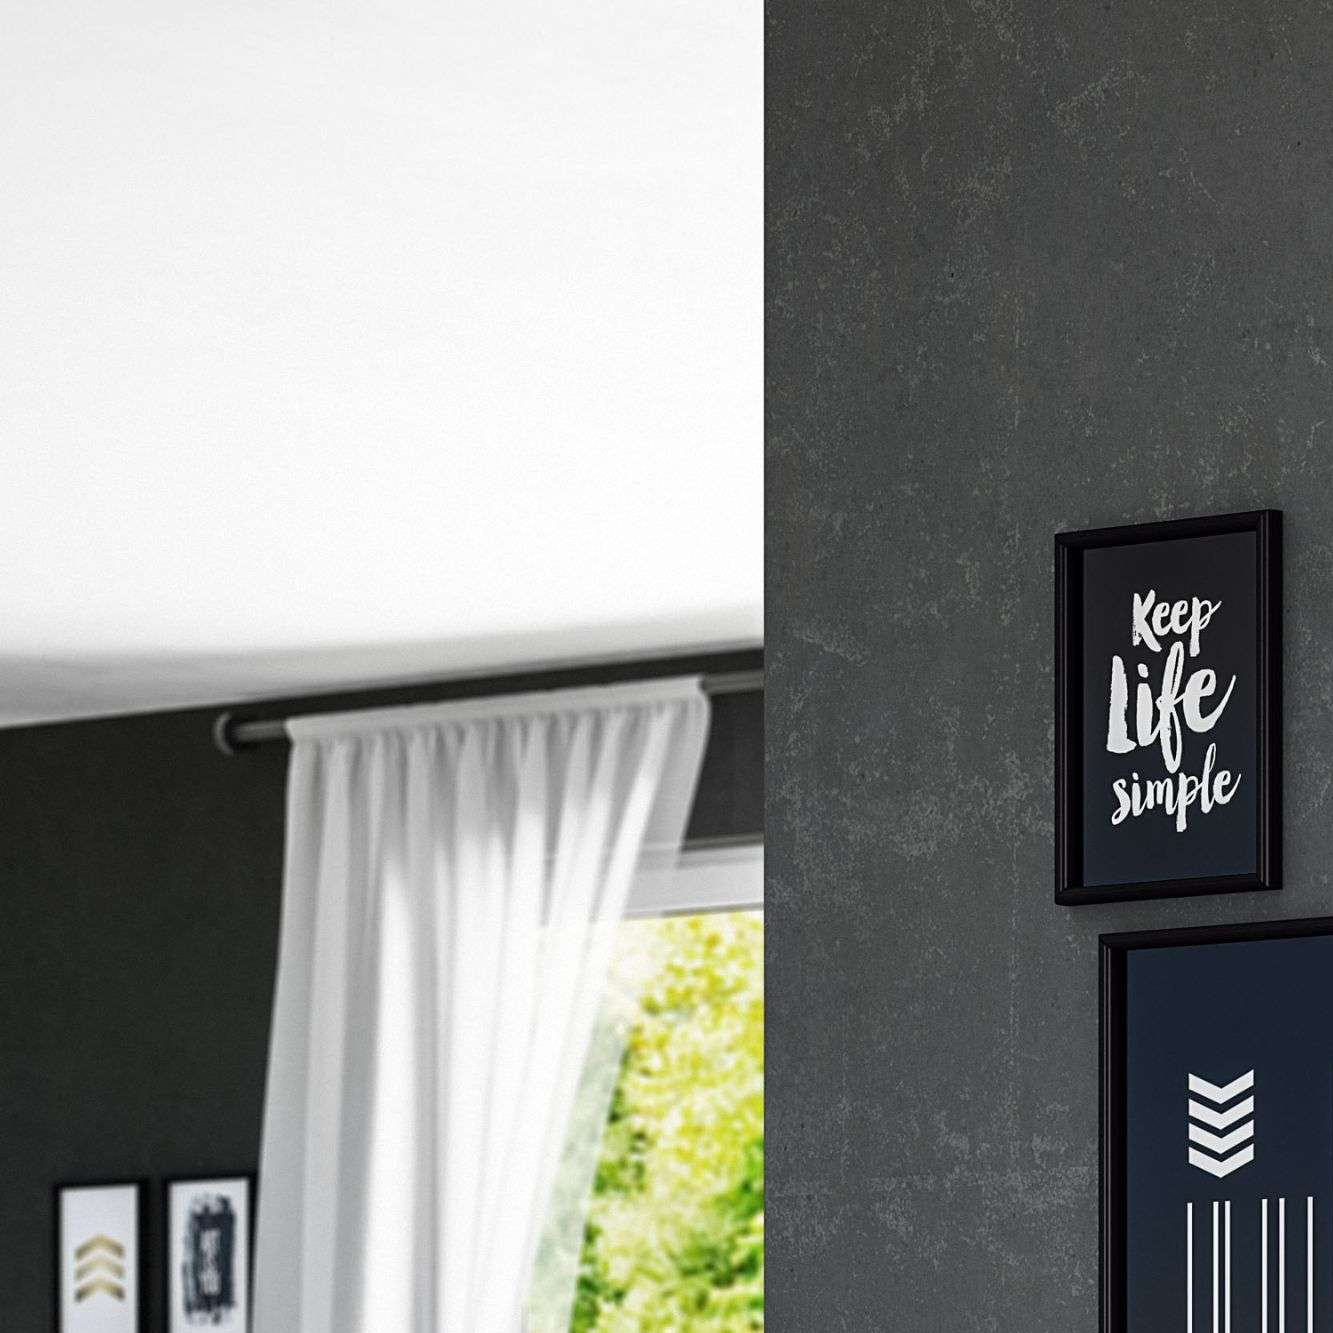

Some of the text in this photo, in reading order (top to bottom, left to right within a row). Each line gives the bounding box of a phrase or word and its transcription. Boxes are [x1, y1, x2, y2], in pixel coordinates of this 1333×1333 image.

[1132, 590, 1222, 657] Keep
[1107, 641, 1236, 773] Life
[1111, 743, 1242, 832] simple
